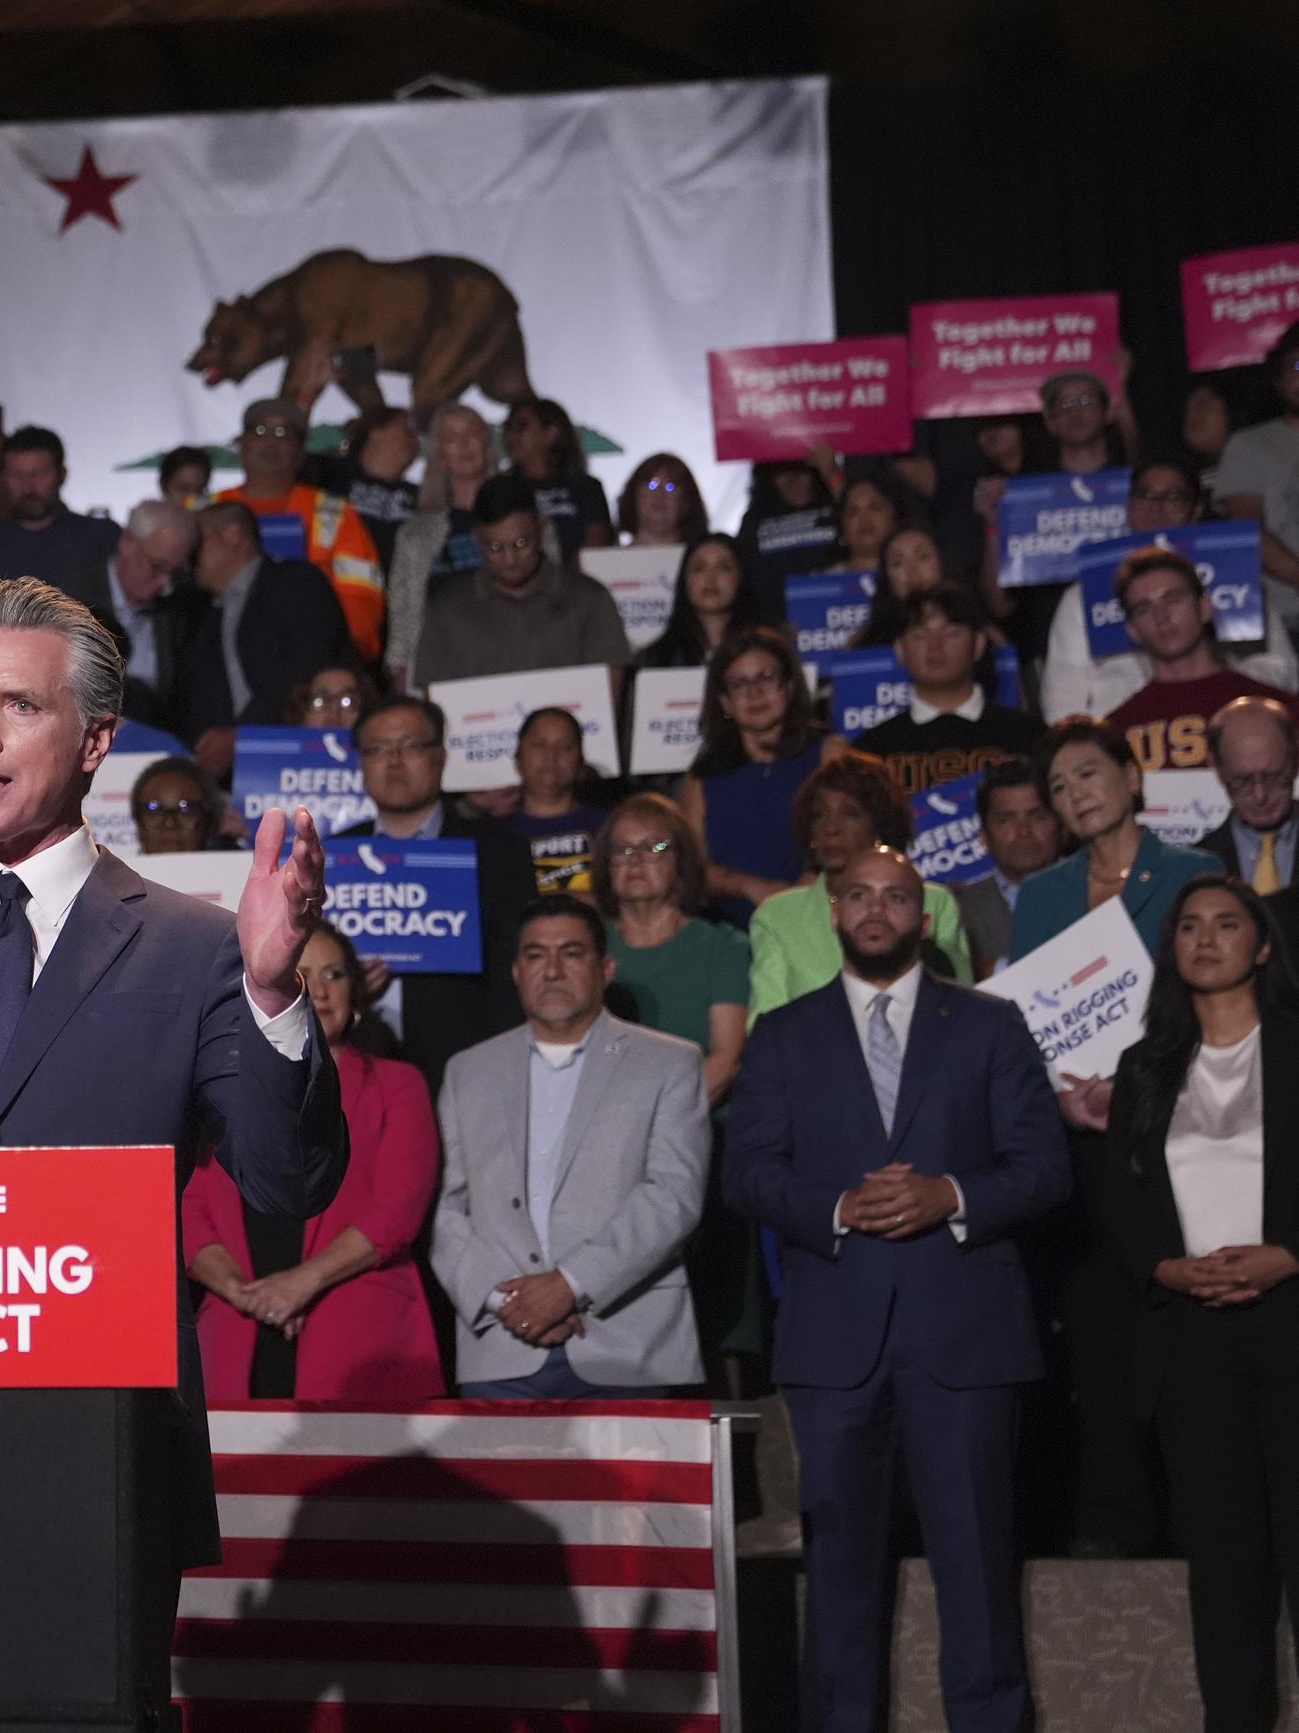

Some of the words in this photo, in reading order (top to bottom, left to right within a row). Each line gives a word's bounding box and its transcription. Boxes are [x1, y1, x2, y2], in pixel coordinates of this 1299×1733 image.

[1211, 292, 1280, 324] Fight
[933, 315, 1049, 346] Together
[1053, 312, 1096, 335] We
[731, 362, 843, 391] Together
[849, 356, 890, 379] We
[937, 345, 1004, 374] Fight
[1010, 341, 1048, 365] for
[1052, 338, 1091, 363] All
[737, 391, 803, 420] Fight
[808, 385, 845, 411] for
[850, 384, 886, 408] All
[1036, 504, 1127, 534] DEFEND
[1125, 714, 1208, 773] US
[280, 768, 364, 794] DEFEN
[244, 793, 380, 822] DEMOCRA
[906, 813, 981, 861] DEFEN
[1062, 970, 1138, 1030] RIGGING
[1096, 997, 1129, 1033] ACT
